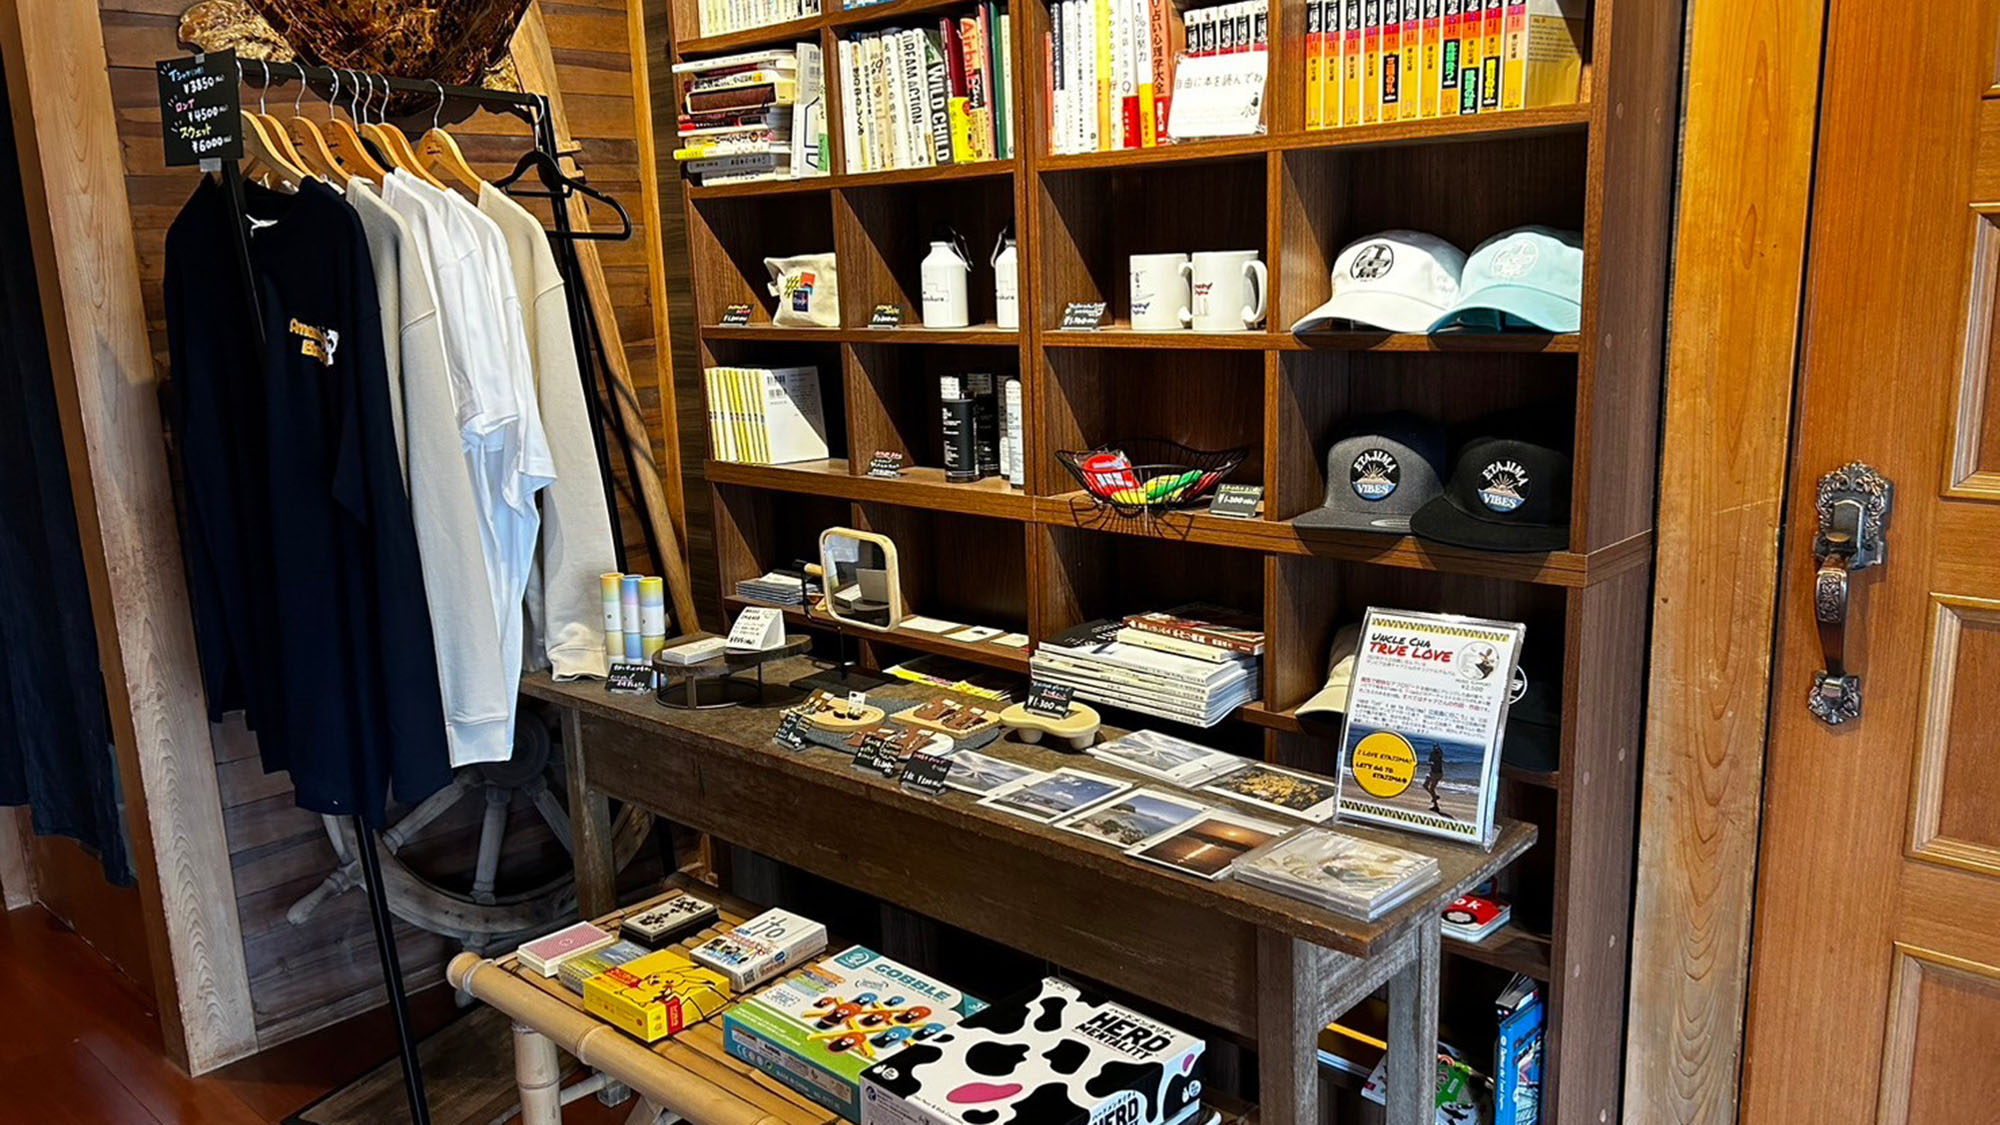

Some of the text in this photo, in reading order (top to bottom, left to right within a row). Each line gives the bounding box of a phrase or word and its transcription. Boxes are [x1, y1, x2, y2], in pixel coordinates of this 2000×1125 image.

[1135, 2, 1147, 62] 1%の努力
[183, 76, 214, 95] ¥3850
[188, 106, 219, 123] ¥4500
[927, 64, 950, 162] WILD CHILD
[180, 123, 212, 139] スウェット
[191, 136, 223, 154] ¥6000
[1353, 450, 1397, 473] ETAJIMA
[1482, 461, 1529, 487] ETAJIMA
[1357, 484, 1390, 495] VIBES
[1483, 493, 1517, 510] VIBES
[1369, 641, 1454, 663] TRUE LOVE
[1362, 751, 1378, 759] LOVE
[747, 916, 787, 938] ito
[874, 963, 952, 1001] GOBBLE
[1074, 1022, 1153, 1060] MENTALITY
[1086, 1011, 1172, 1053] HERD
